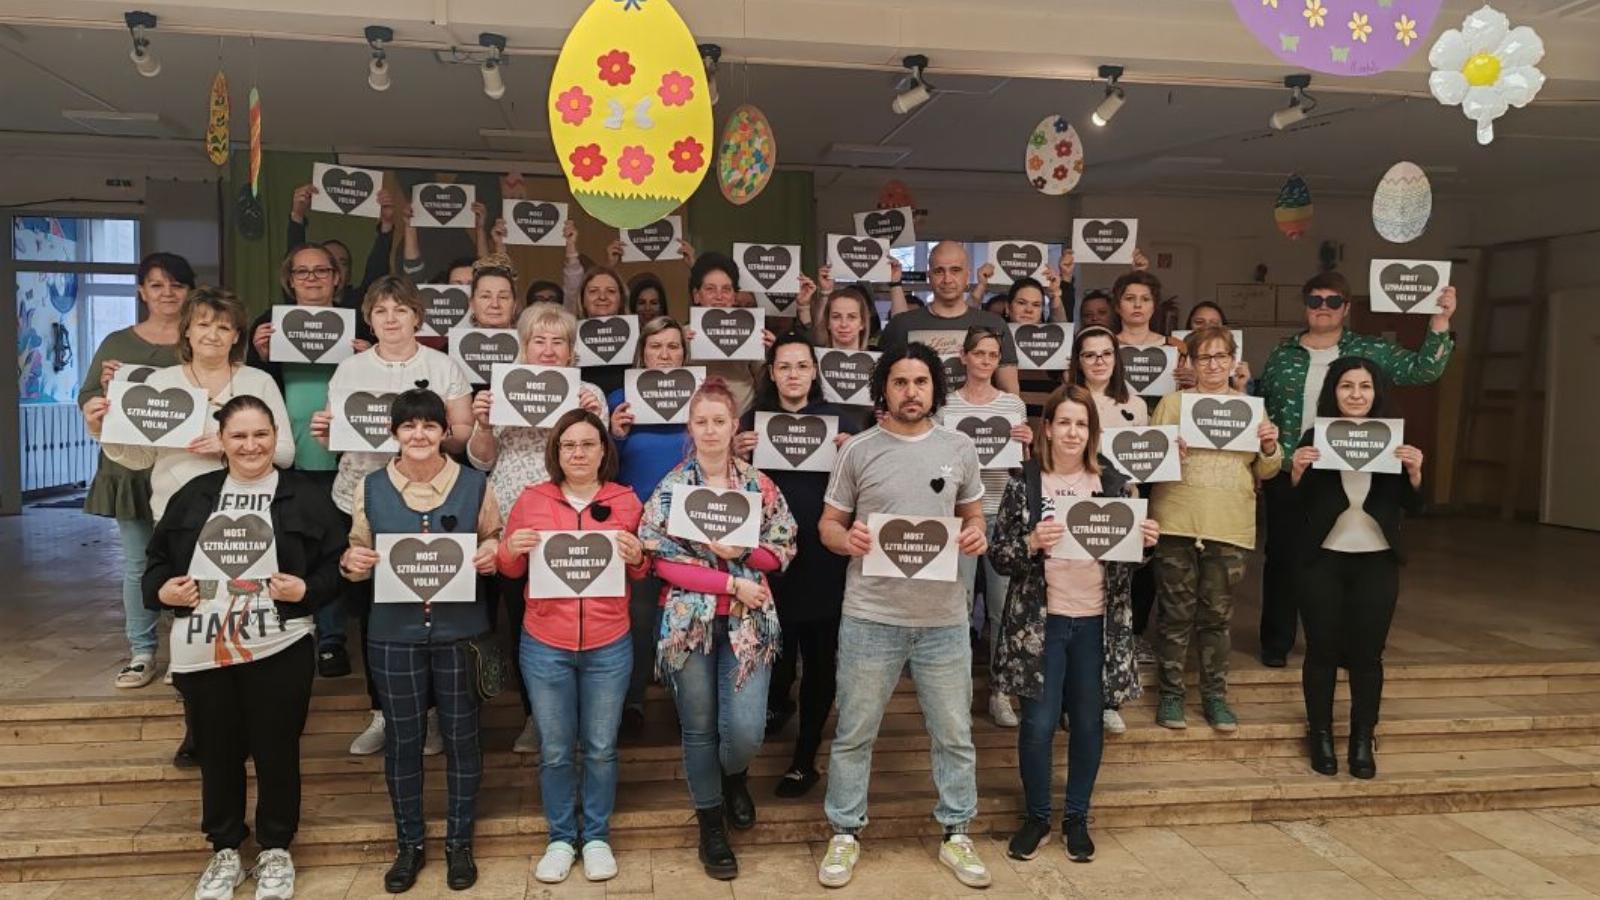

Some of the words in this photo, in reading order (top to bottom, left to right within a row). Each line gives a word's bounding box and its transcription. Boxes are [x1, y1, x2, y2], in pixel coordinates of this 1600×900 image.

[526, 382, 546, 390] MOST
[147, 398, 169, 407] MOST
[523, 405, 546, 413] VOLNA
[142, 420, 168, 430] VOLNA
[1090, 514, 1111, 522] MOST
[224, 528, 246, 537] MOST
[903, 532, 924, 540] MOST
[204, 539, 266, 550] SZTRÁJKOLTAM
[1086, 538, 1110, 546] VOLNA
[568, 546, 589, 555] MOST
[221, 554, 248, 564] VOLNA
[416, 552, 438, 561] MOST
[899, 555, 922, 563] VOLNA
[397, 562, 456, 574] SZTRÁJKOLTAM
[566, 571, 590, 580] VOLNA
[413, 577, 439, 587] VOLNA
